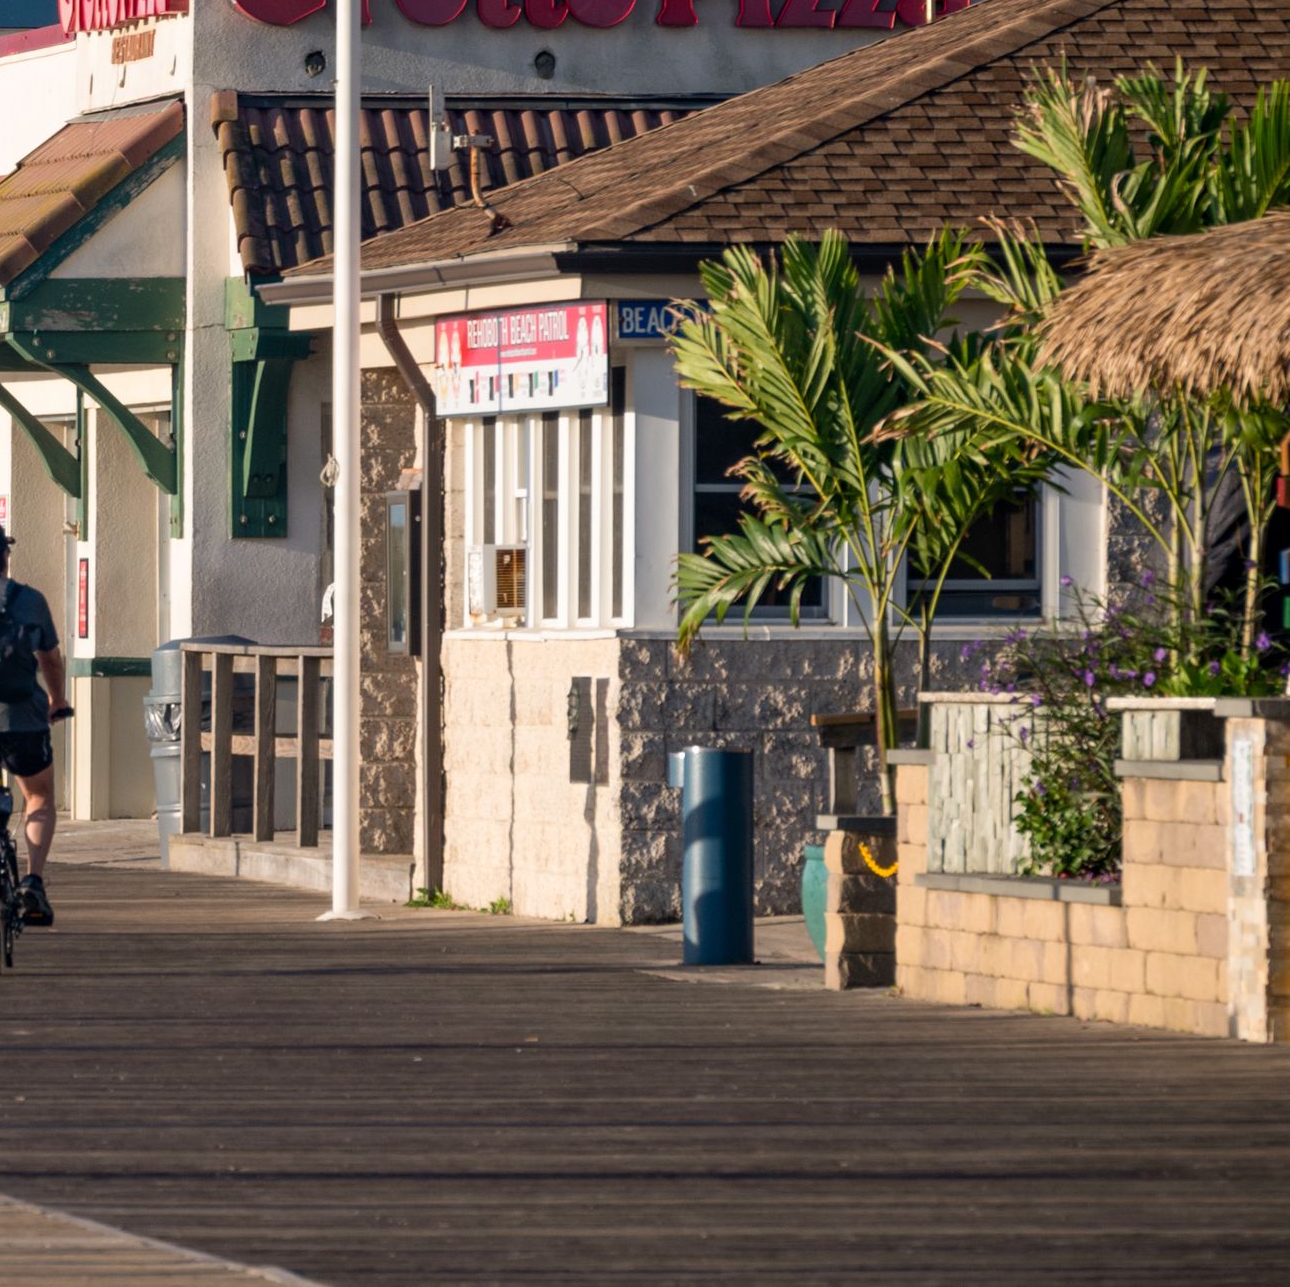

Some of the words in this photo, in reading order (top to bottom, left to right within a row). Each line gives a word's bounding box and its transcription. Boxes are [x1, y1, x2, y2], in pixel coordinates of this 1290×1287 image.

[467, 316, 508, 349] REHOBOTH
[510, 313, 536, 345] BEACH
[539, 310, 569, 342] PATROL
[622, 307, 685, 333] BEAC
